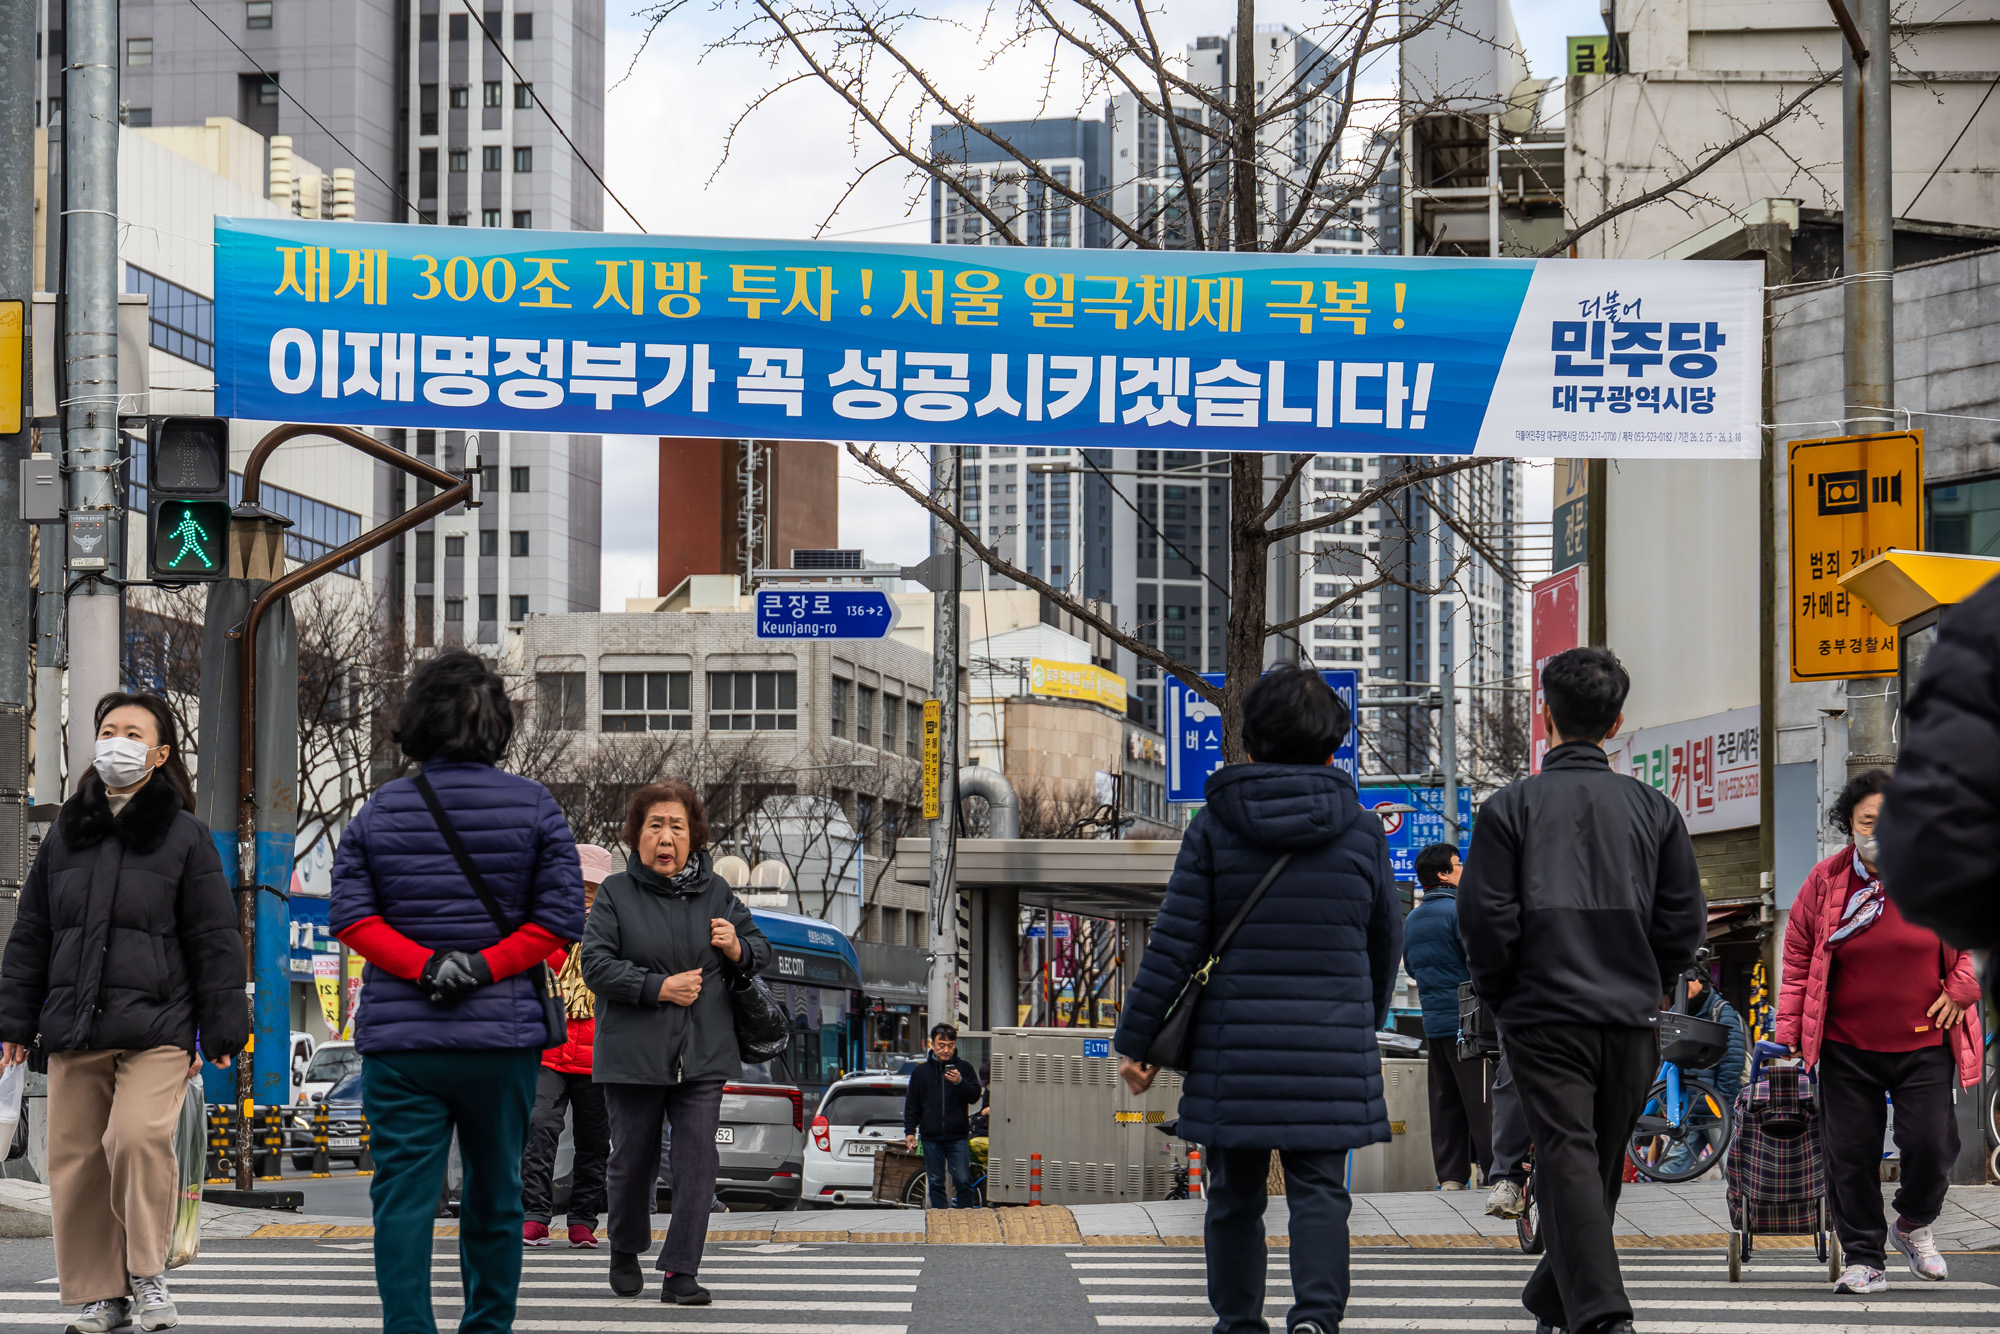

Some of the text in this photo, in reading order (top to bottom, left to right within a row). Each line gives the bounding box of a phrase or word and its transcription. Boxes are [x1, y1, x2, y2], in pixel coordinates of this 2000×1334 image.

[274, 246, 388, 305] 재계
[411, 253, 572, 309] 300조
[592, 259, 708, 318] 지방
[891, 269, 1003, 326] 서울
[1024, 273, 1243, 333] 일극체제
[1578, 290, 1642, 323] 더불어
[1551, 320, 1726, 379] 민주당
[269, 327, 1435, 430] 이재명정부가 꼭 성공시키겠습니다!
[1552, 385, 1716, 415] 대구광역시당
[1515, 430, 1546, 442] 더불어민주당
[1547, 430, 1577, 442] 대구광역시당
[1578, 431, 1617, 442] 053-217-0700
[1634, 431, 1673, 442] 053-523-0182
[1564, 501, 1588, 557] 전문
[1810, 550, 1840, 580] 범죄
[763, 594, 832, 618] 큰장로
[1802, 591, 1850, 620] 카메라
[762, 621, 837, 636] Keunjang-ro
[1818, 635, 1895, 656] 중부경찰서
[925, 705, 939, 717] CCTV
[1092, 1043, 1108, 1053] LT18
